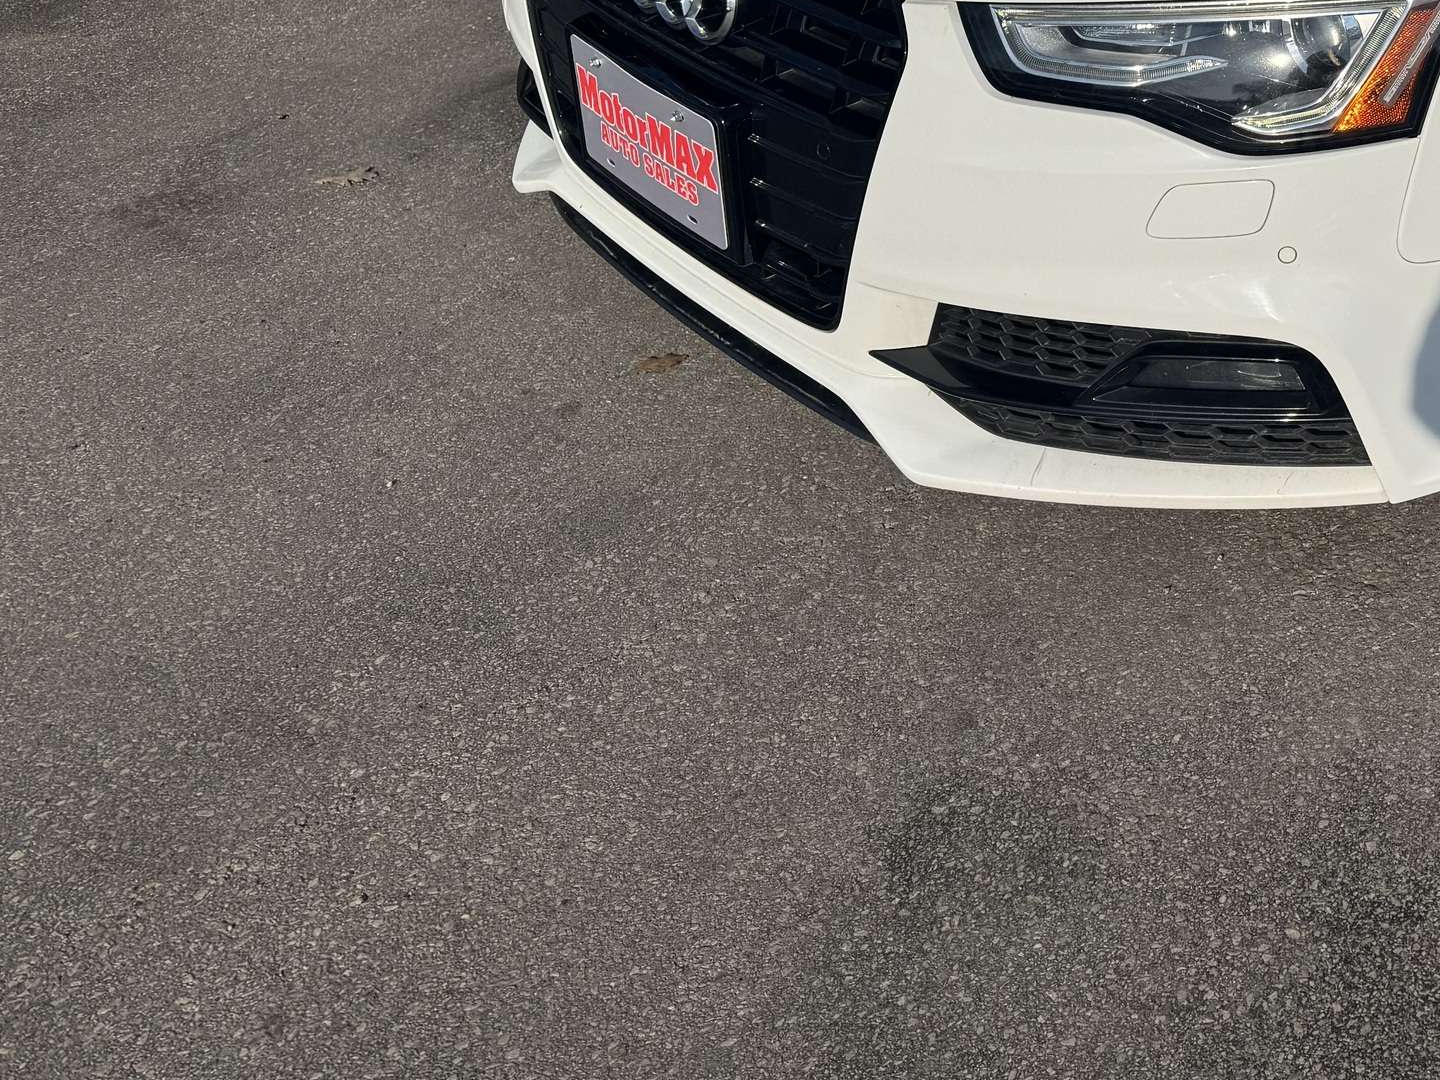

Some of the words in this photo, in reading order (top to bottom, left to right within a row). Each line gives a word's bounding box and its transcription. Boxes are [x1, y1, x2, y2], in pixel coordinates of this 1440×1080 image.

[576, 63, 719, 194] MotorMAX
[600, 121, 640, 167] AUTO
[642, 153, 700, 206] SALES
